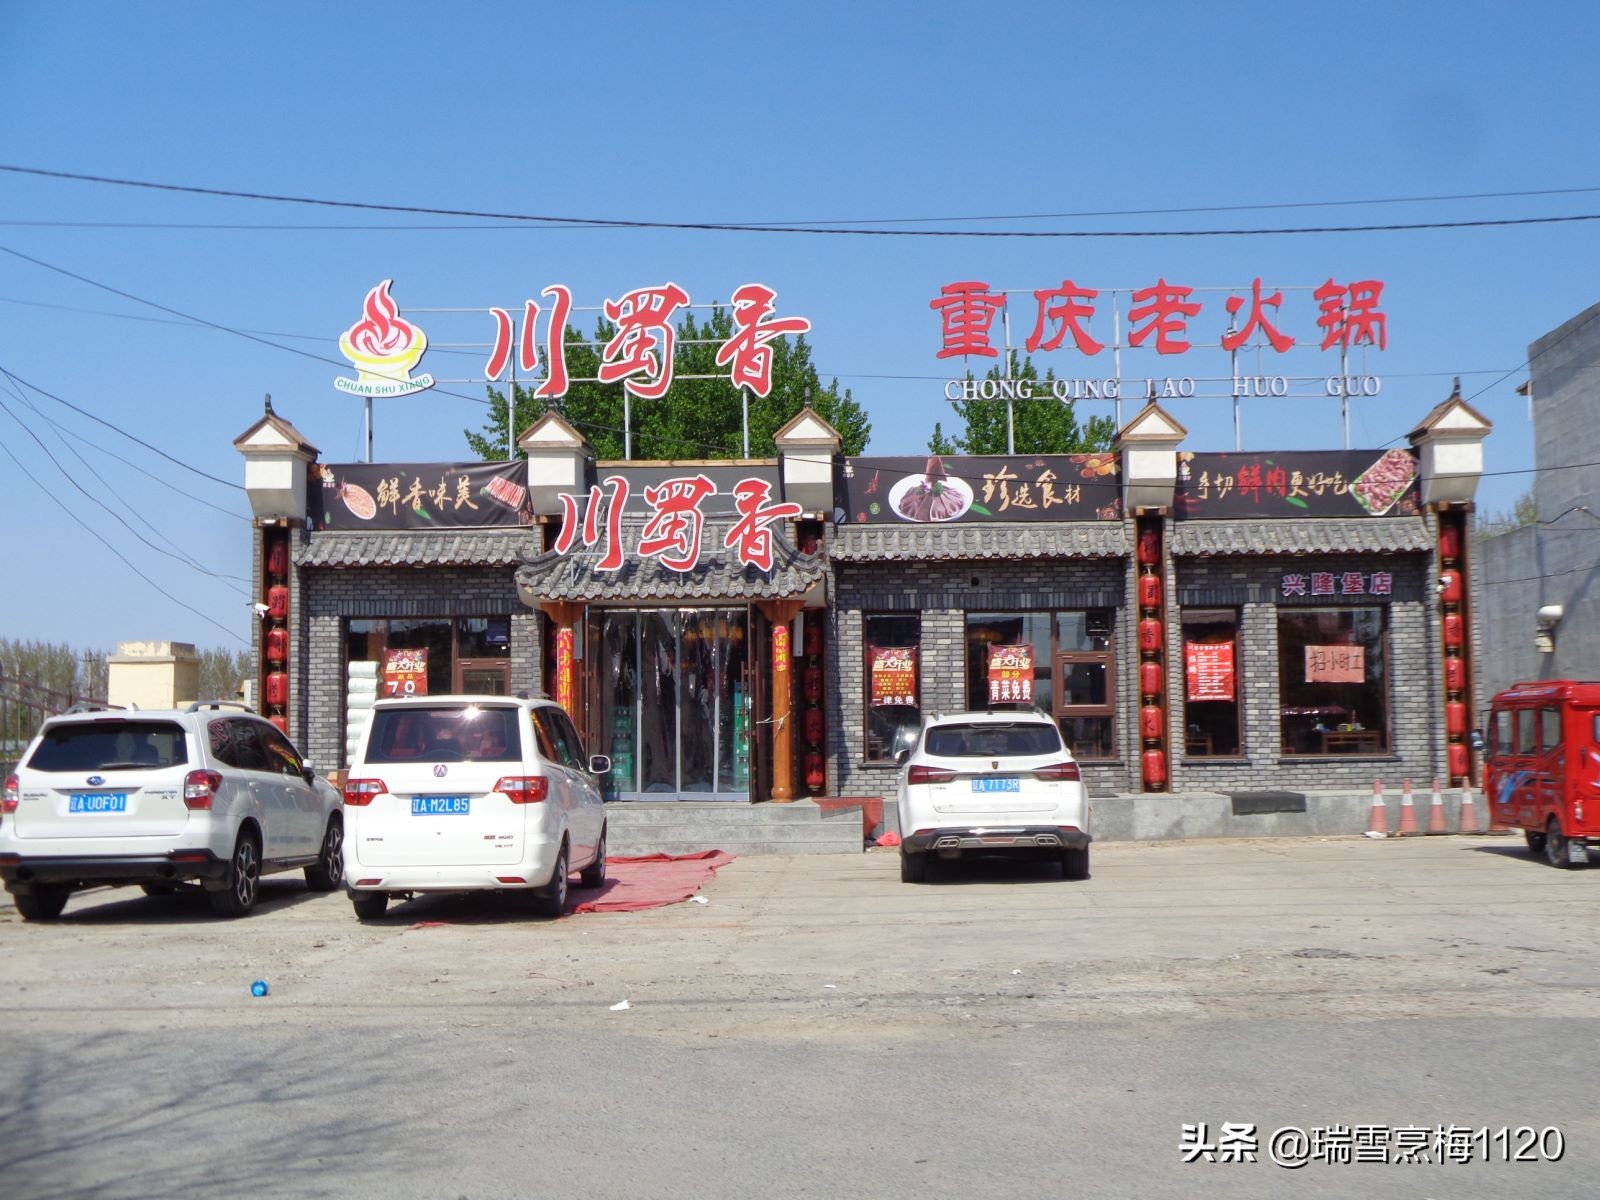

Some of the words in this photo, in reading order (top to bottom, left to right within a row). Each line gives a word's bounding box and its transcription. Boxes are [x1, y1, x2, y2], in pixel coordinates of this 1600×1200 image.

[930, 277, 1387, 359] 重庆老火锅
[485, 282, 811, 399] 川蜀香
[337, 379, 372, 393] CHUAN
[375, 386, 396, 394] SHU
[399, 376, 430, 392] XIANG
[944, 379, 1033, 400] CHONG
[1053, 378, 1119, 404] QING
[1144, 376, 1196, 398] LAO
[1232, 376, 1289, 397] HUO
[1326, 376, 1381, 397] GUO
[377, 475, 478, 515] 鲜香味美
[554, 474, 802, 572] 川蜀香
[1282, 572, 1393, 597] 兴隆堡店
[990, 680, 1031, 701] 青菜免费
